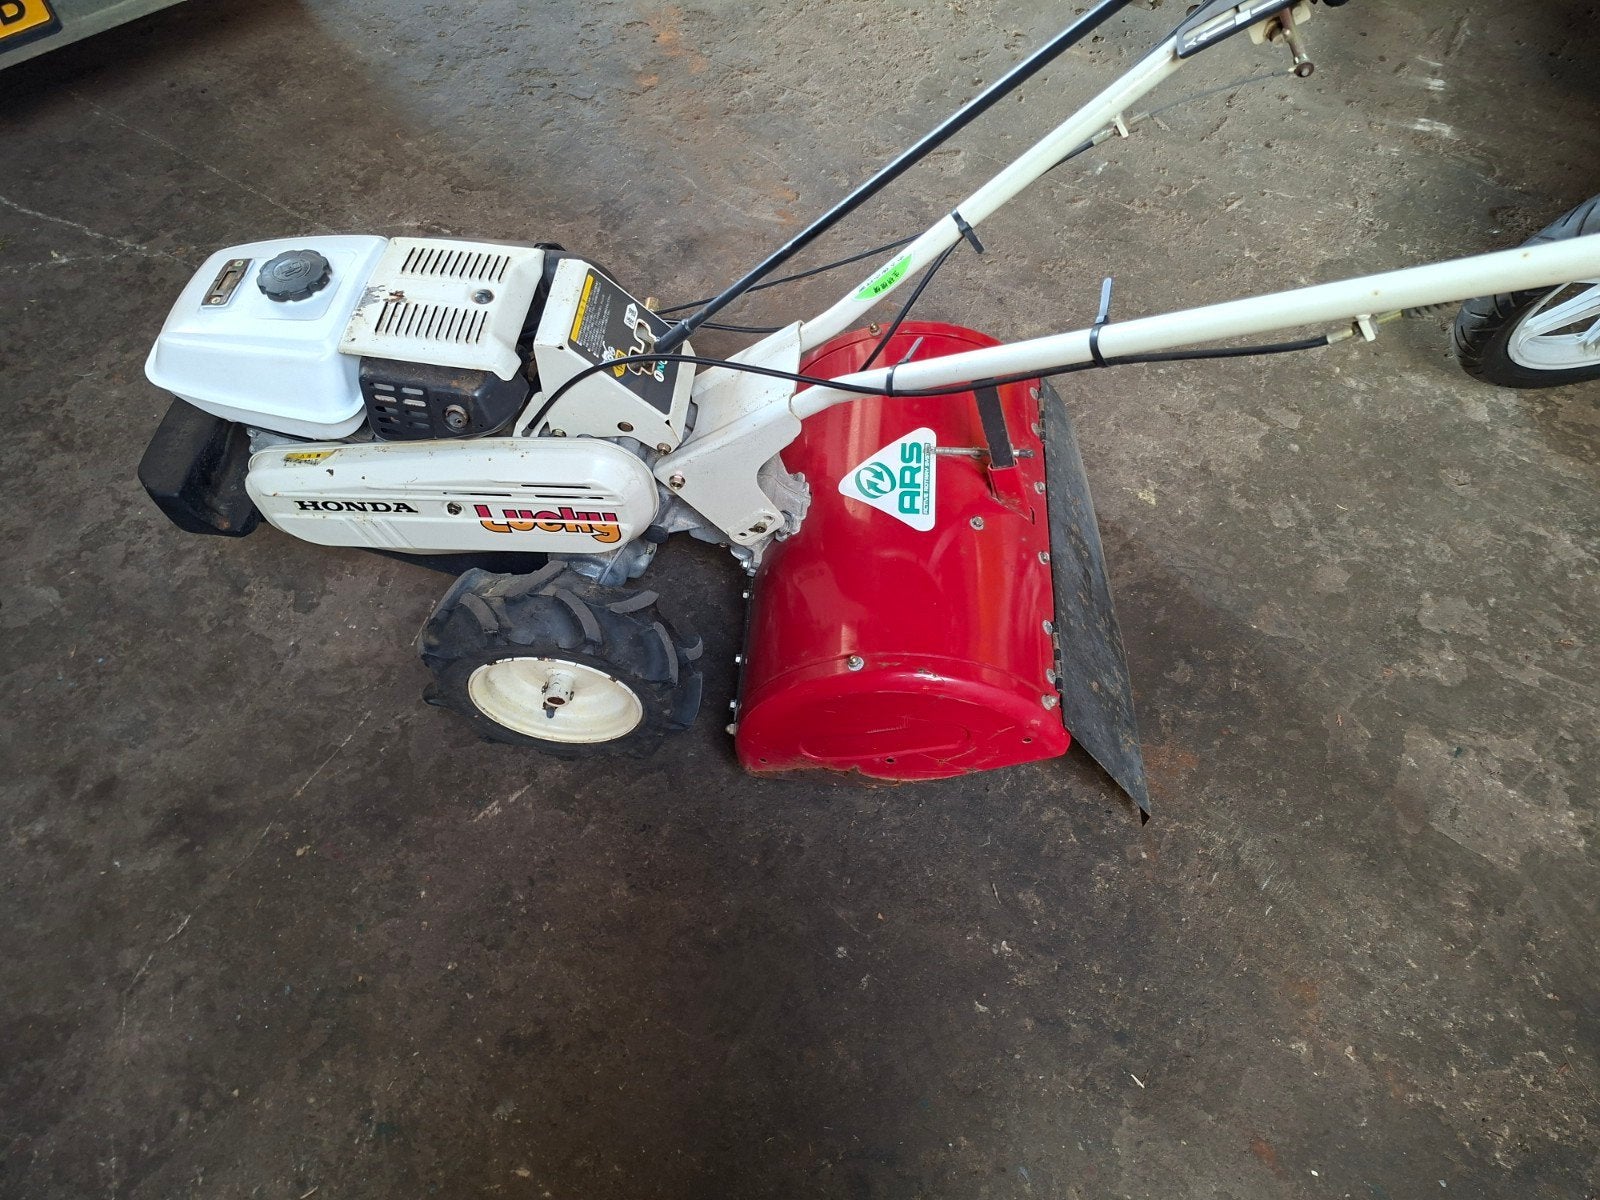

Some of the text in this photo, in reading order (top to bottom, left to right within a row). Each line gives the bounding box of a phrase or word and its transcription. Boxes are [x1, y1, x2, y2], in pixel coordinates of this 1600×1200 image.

[898, 442, 922, 515] ARS
[294, 501, 418, 513] HONDA
[473, 504, 622, 543] Lucky
